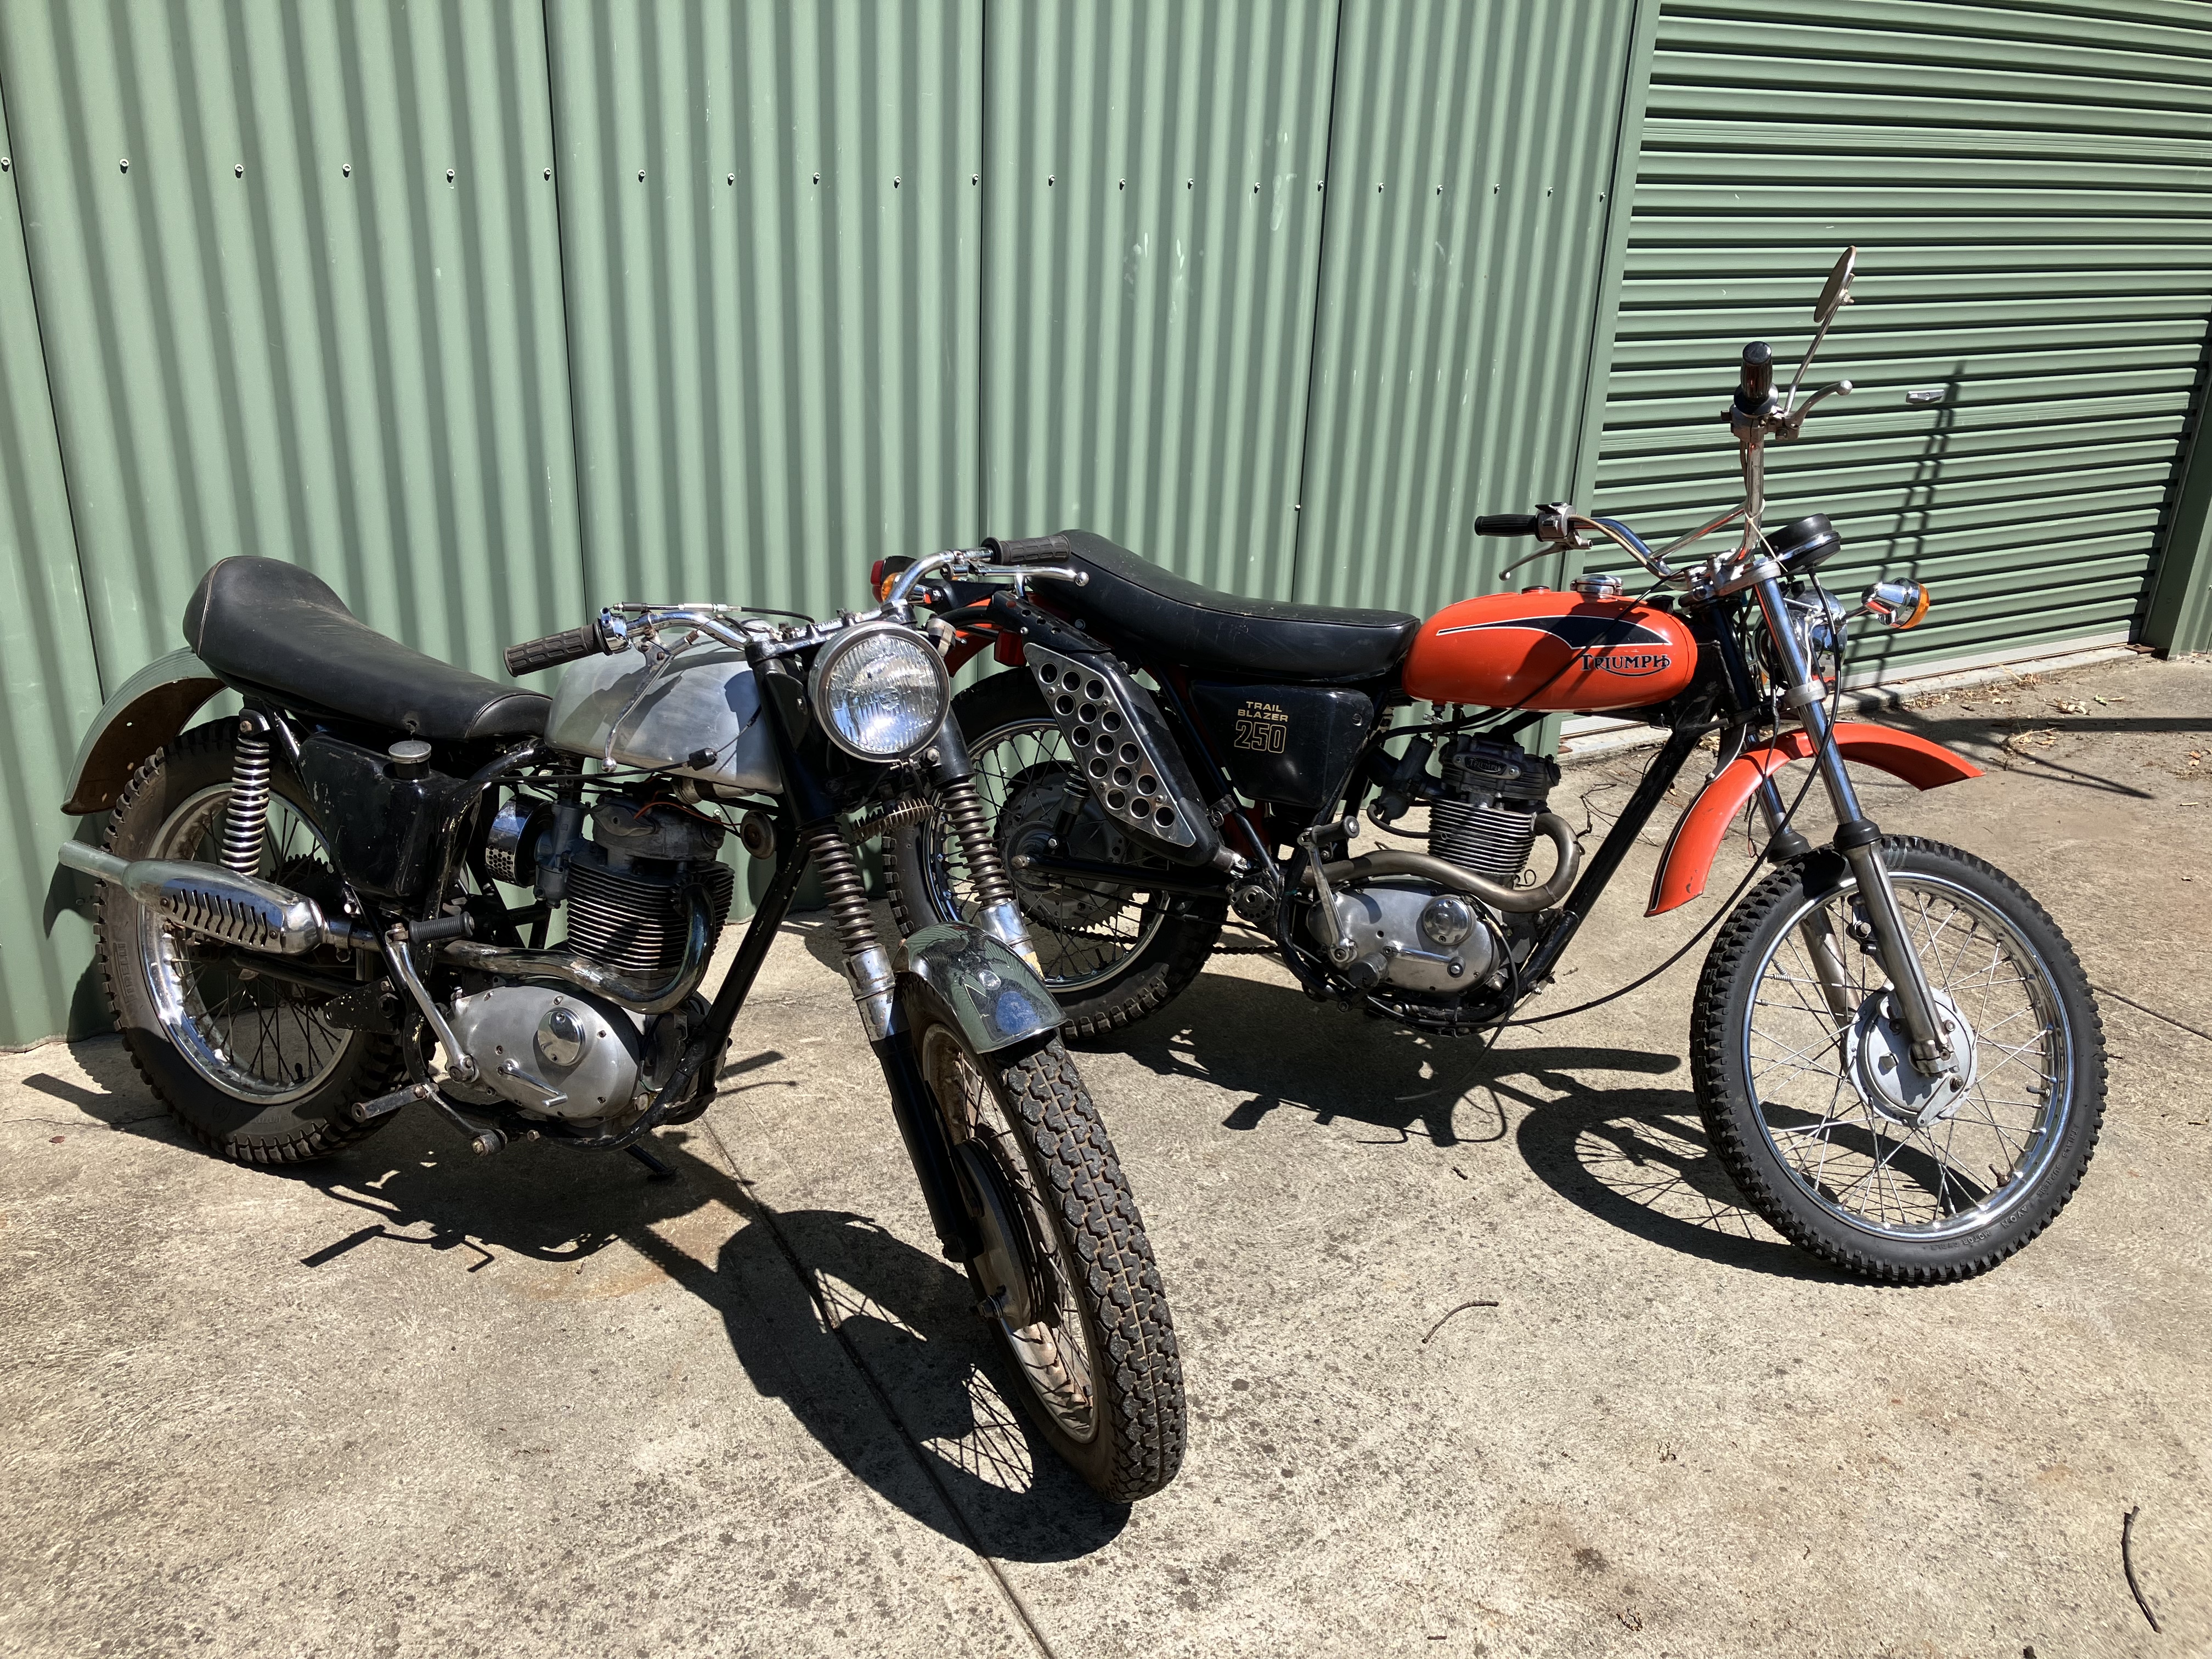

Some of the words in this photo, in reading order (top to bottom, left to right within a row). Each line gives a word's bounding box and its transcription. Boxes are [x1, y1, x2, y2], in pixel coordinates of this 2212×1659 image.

[1581, 654, 1672, 677] TRIUMPH
[1238, 709, 1289, 722] BLAZER
[1246, 701, 1283, 712] TRAIL
[1234, 720, 1286, 754] 250
[1470, 758, 1502, 772] TRIUMPH
[114, 943, 138, 1003] PIRELLI
[2062, 1128, 2078, 1159] TRIALS
[2036, 1163, 2063, 1198] SUPREME
[2001, 1205, 2030, 1228] AVON
[1930, 1242, 1960, 1251] CYCLE
[1962, 1230, 1991, 1245] MOTOR
